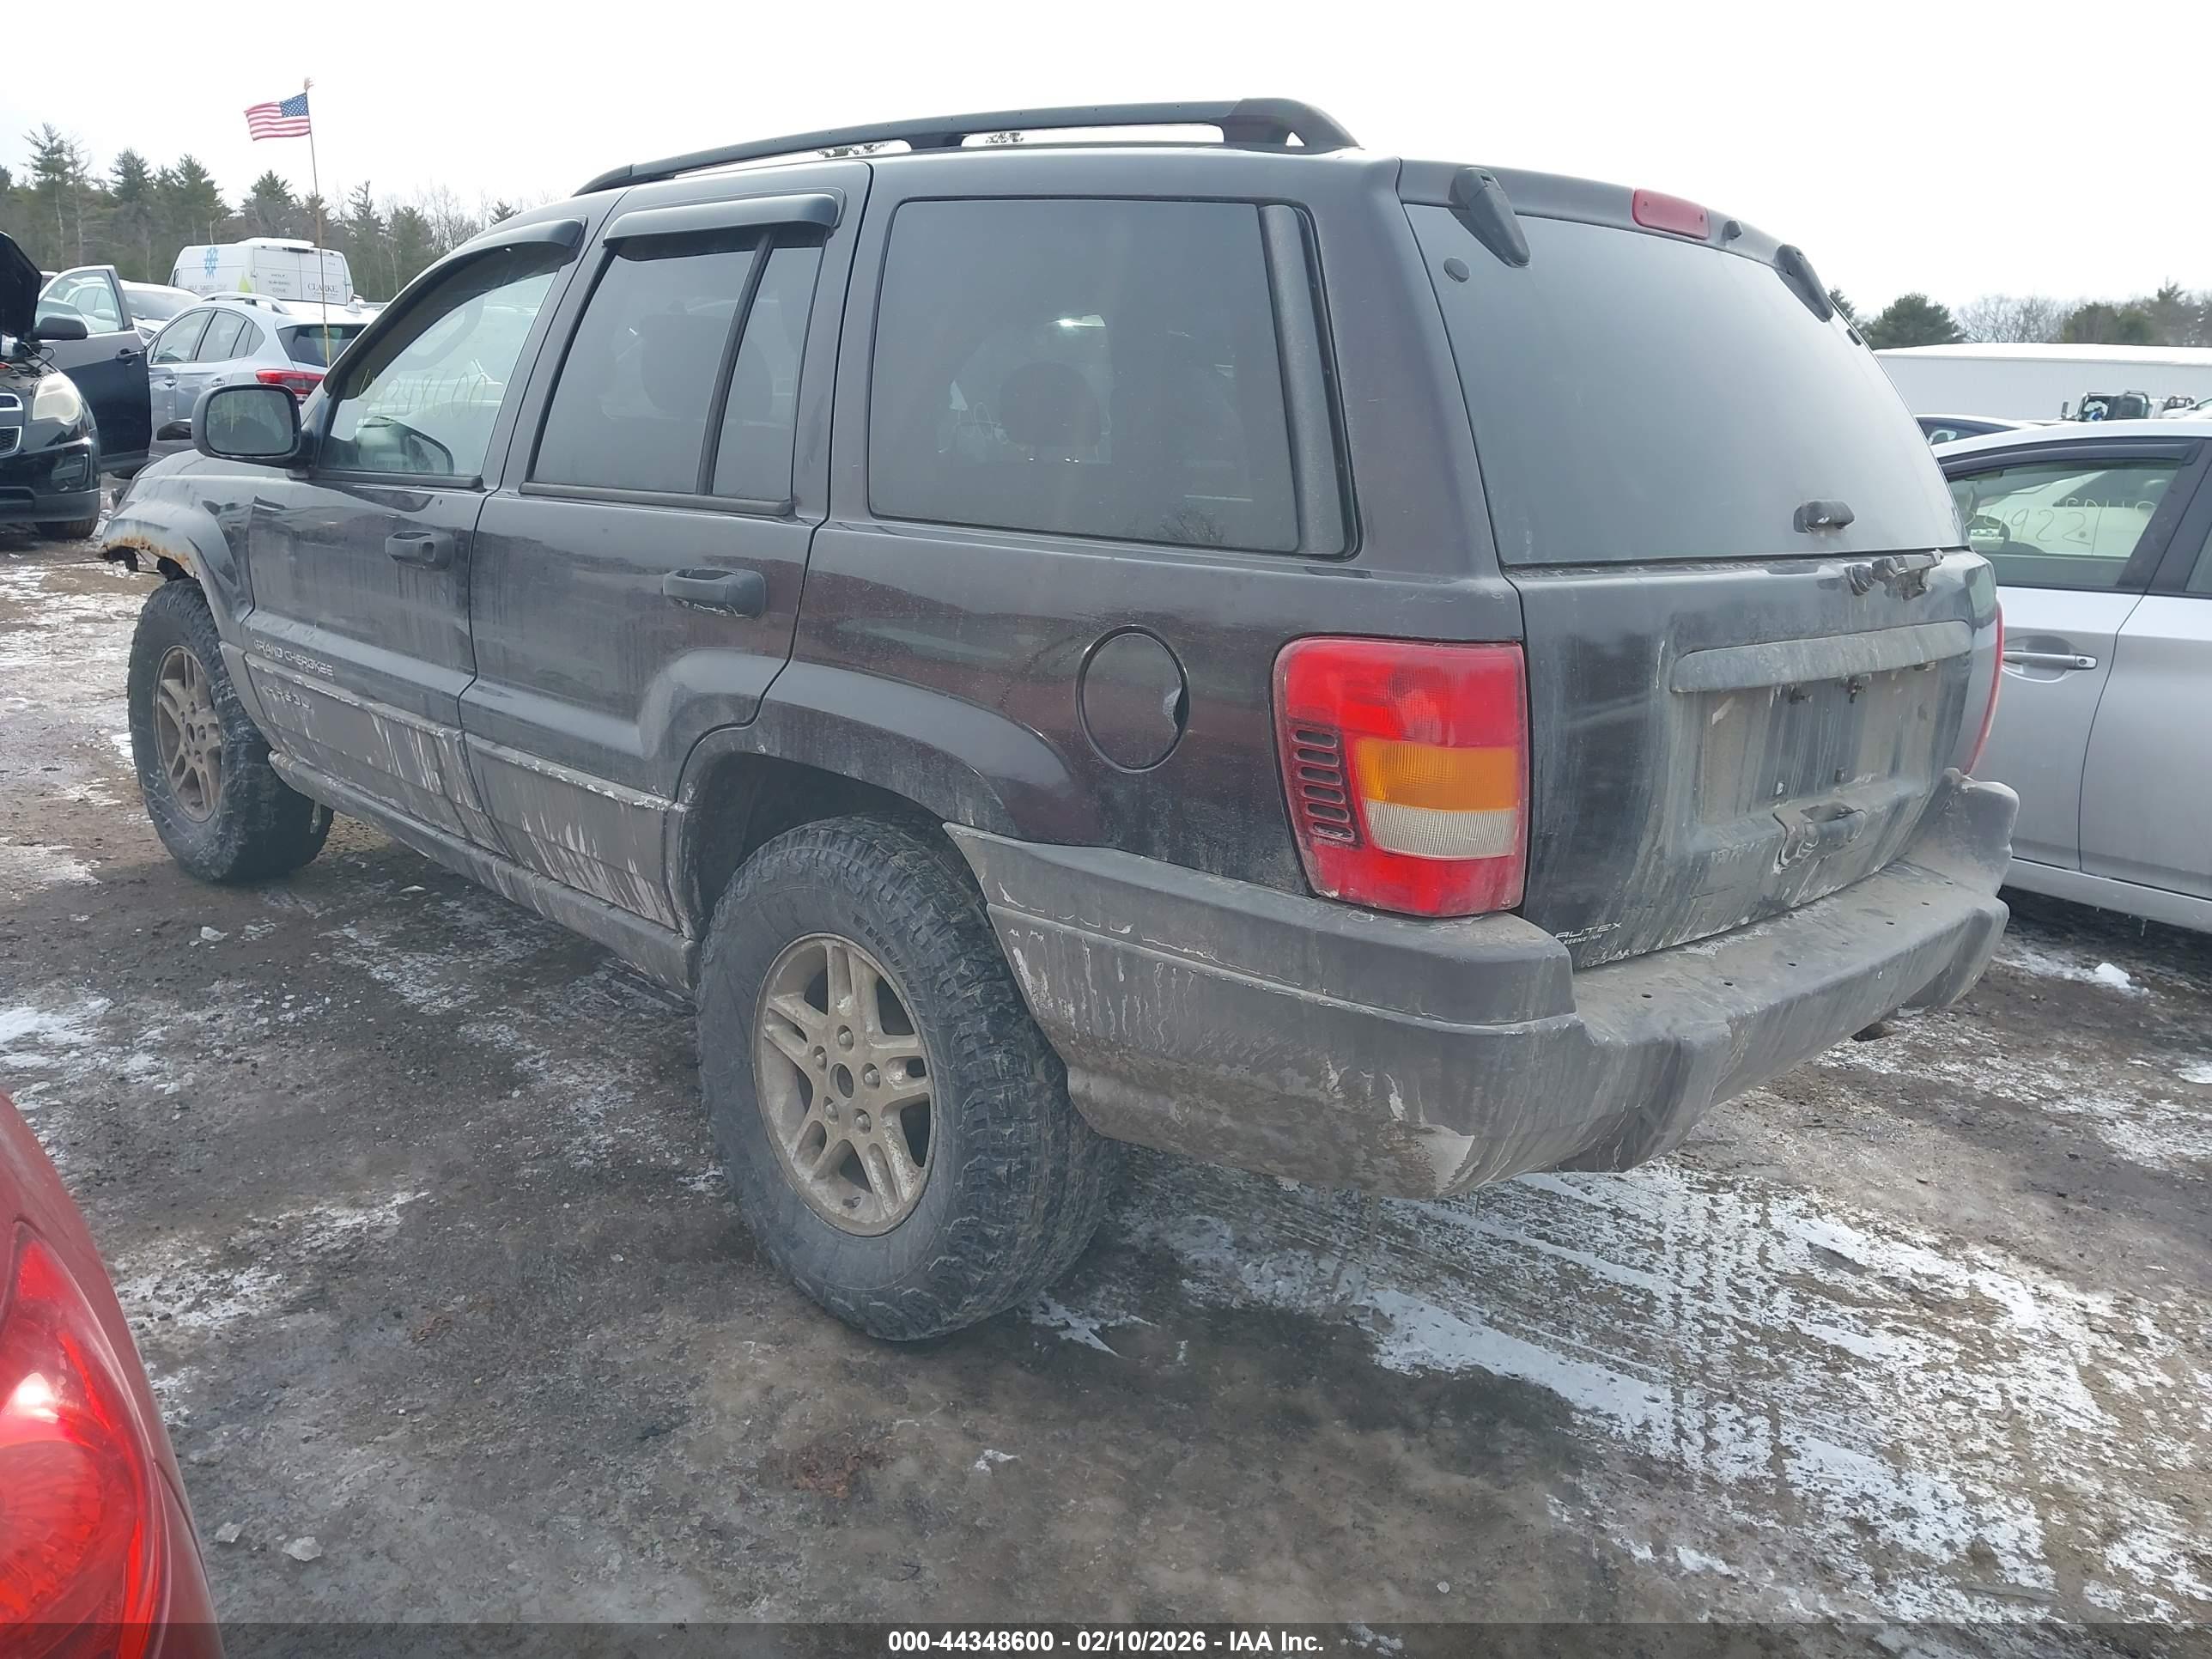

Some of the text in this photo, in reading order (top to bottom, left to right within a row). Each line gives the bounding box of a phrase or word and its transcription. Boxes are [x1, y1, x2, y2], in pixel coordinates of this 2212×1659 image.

[307, 283, 337, 293] CLARKE
[253, 639, 283, 659] GRAND
[1554, 922, 1622, 939] AUTEX
[1564, 936, 1588, 945] KEENE
